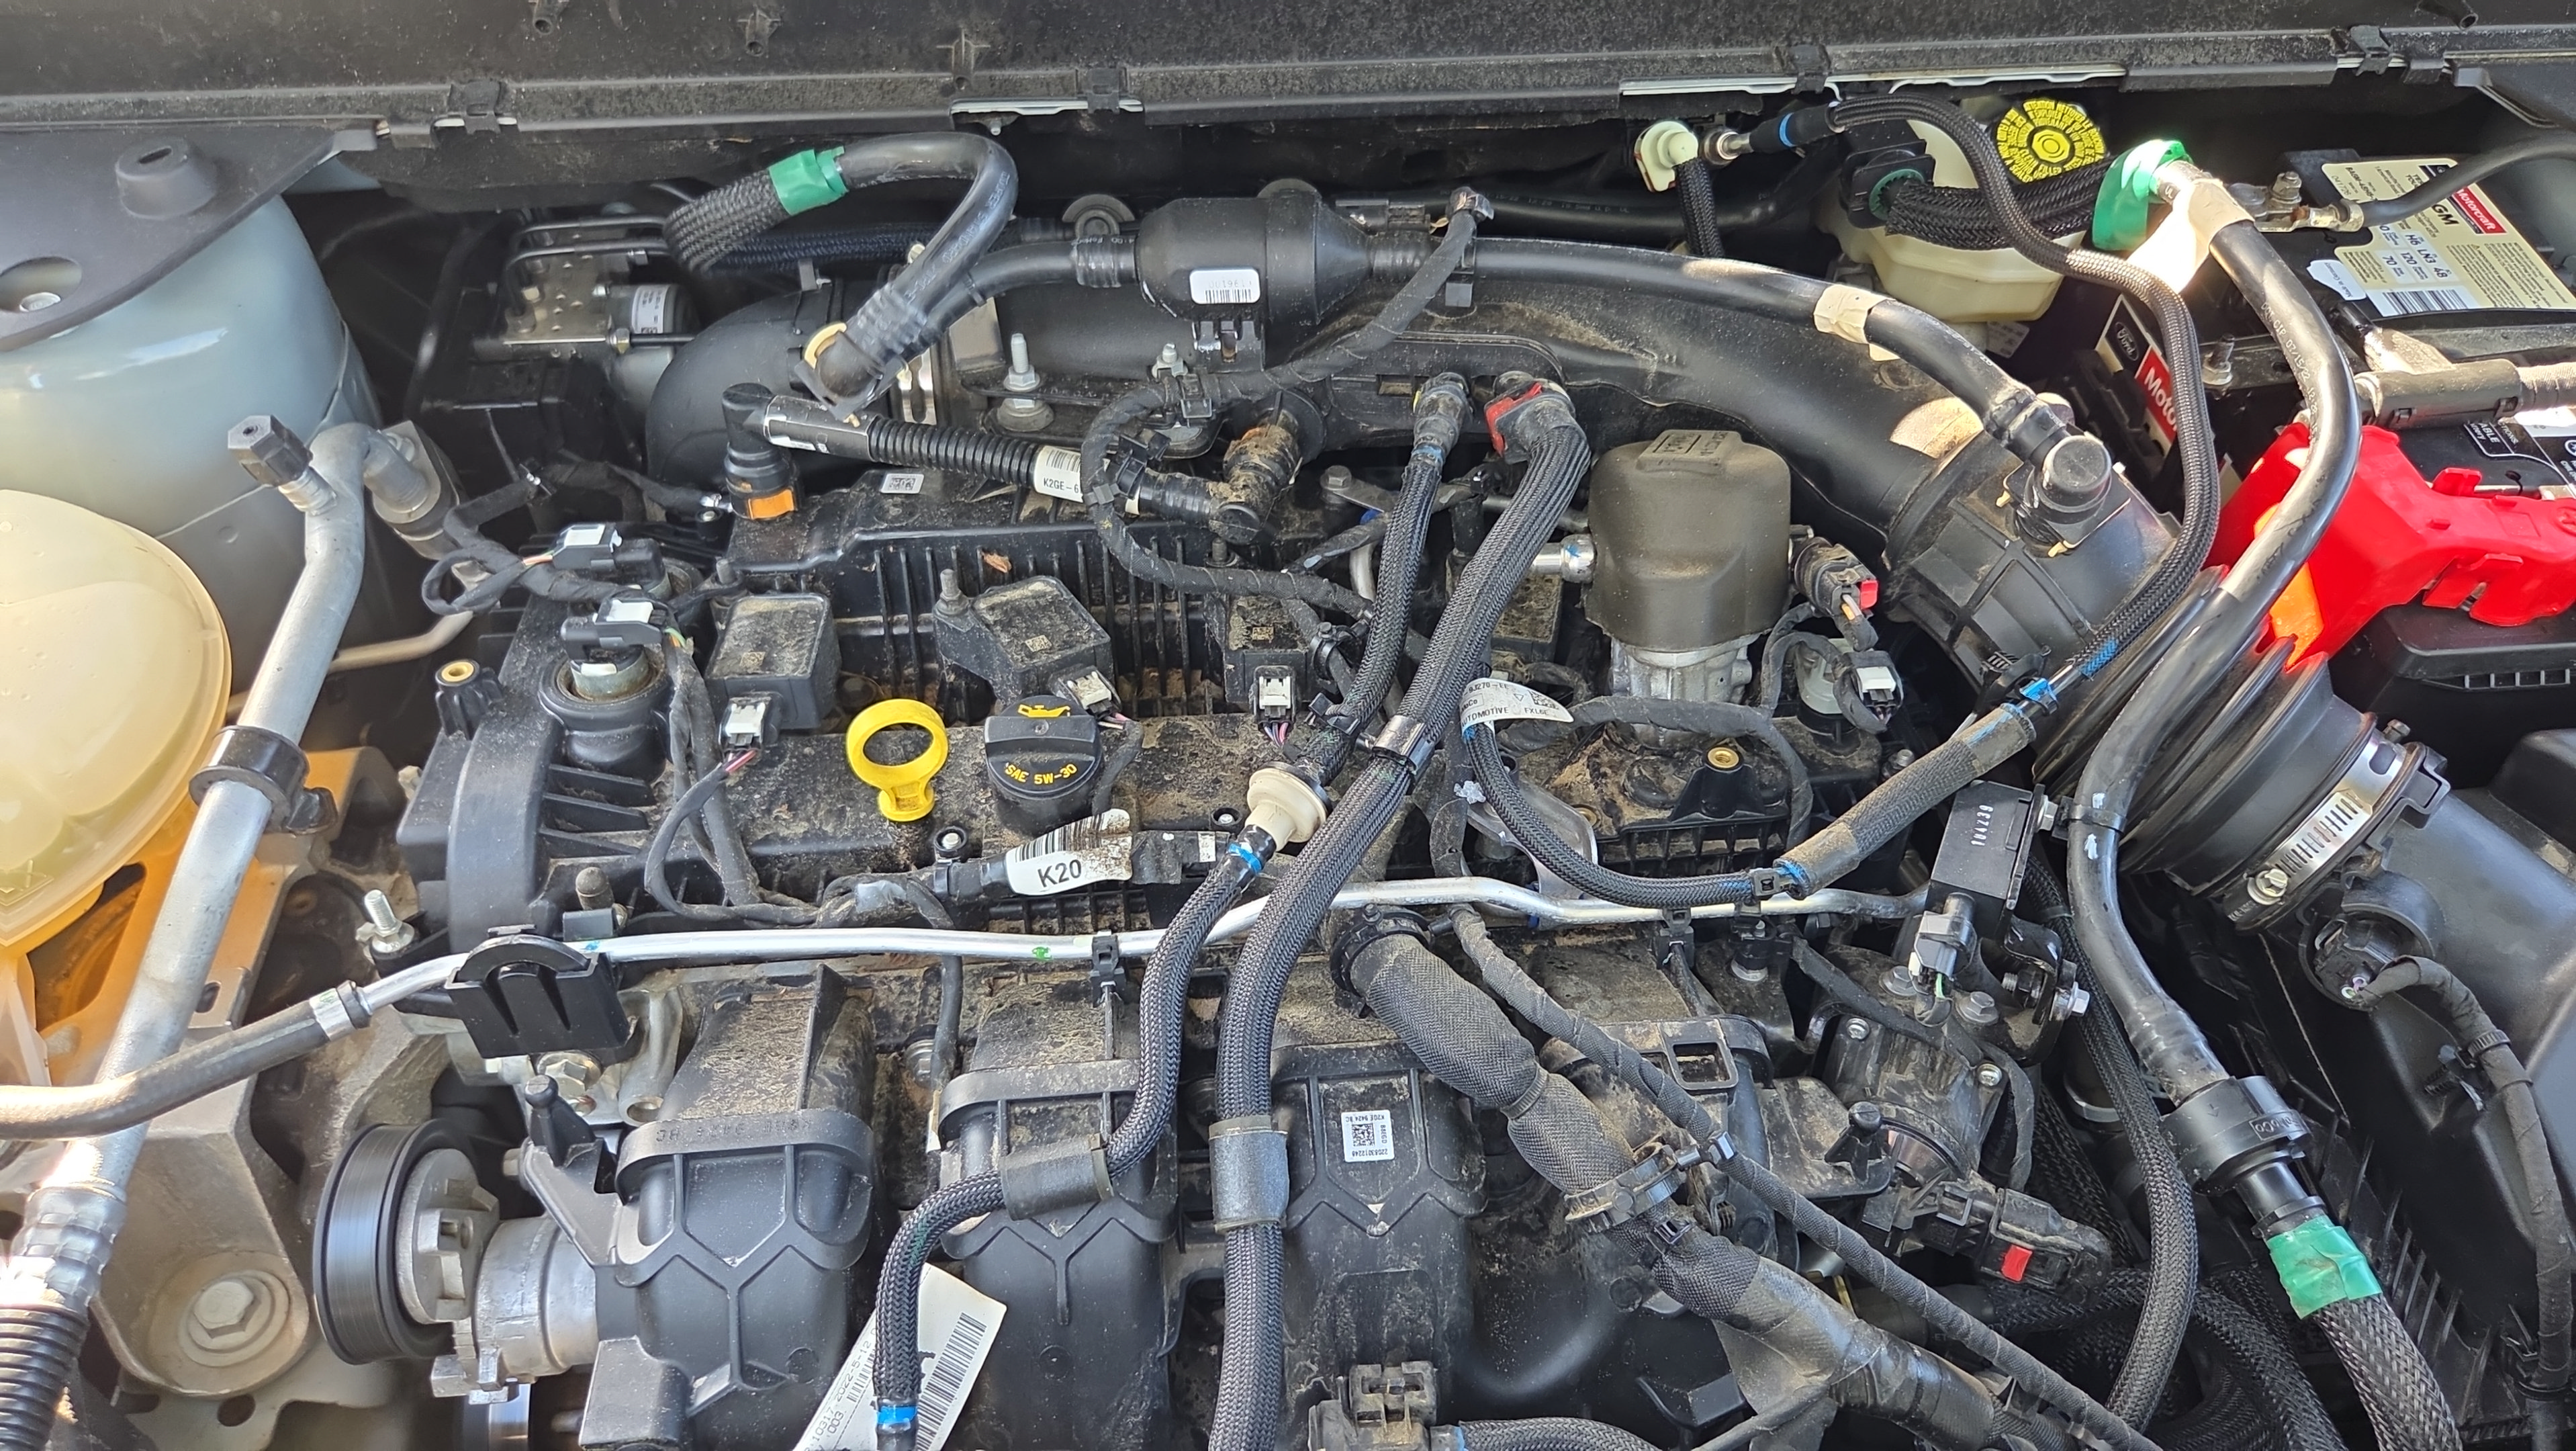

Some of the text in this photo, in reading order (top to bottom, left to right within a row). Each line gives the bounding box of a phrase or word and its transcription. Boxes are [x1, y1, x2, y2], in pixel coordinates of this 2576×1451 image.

[2056, 101, 2086, 123] NETTOYER
[2082, 119, 2093, 129] LE
[2381, 255, 2398, 266] 70
[2399, 251, 2418, 265] 120
[2405, 234, 2423, 245] H6
[2416, 249, 2436, 263] LN3
[2433, 266, 2448, 278] 48
[2117, 327, 2135, 357] Ford
[1462, 707, 1510, 728] AUTOMOTIVE
[1005, 763, 1077, 785] SAE 5W-30
[1037, 859, 1083, 888] K20
